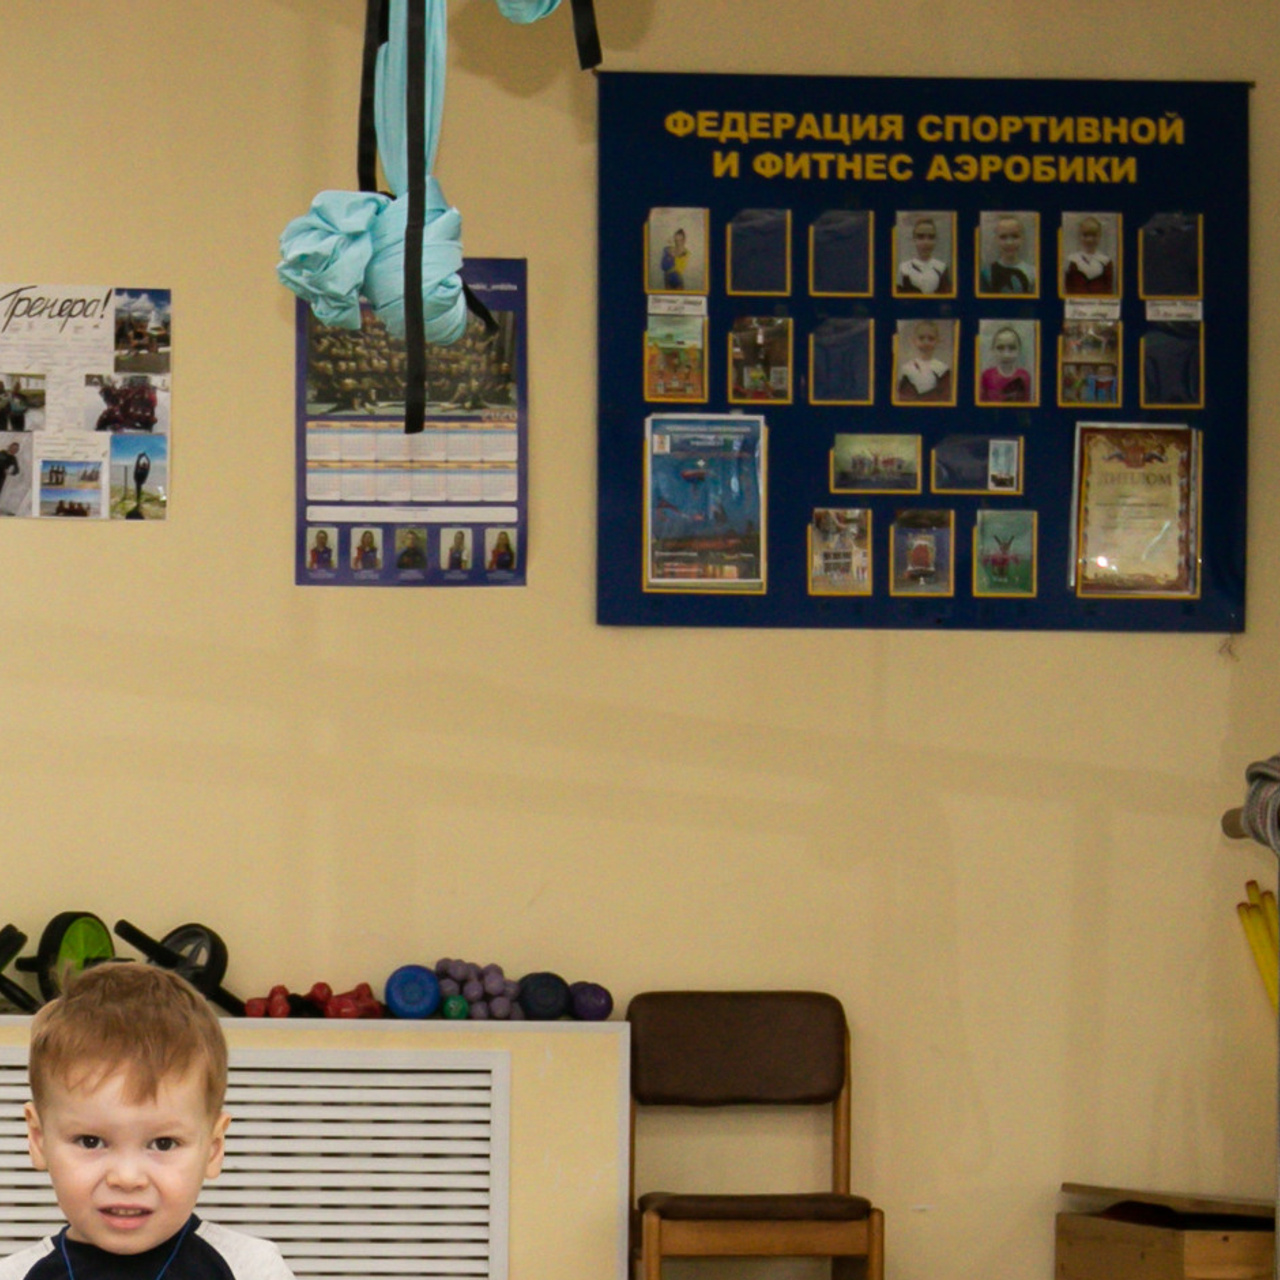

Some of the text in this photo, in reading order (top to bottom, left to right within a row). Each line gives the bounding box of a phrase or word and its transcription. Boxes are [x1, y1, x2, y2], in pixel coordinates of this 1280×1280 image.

[664, 110, 1185, 146] ФЕДЕРАЦИЯ СПОРТИВНОЙ
[712, 150, 1138, 184] И ФИТНЕС АЭРОБИКИ
